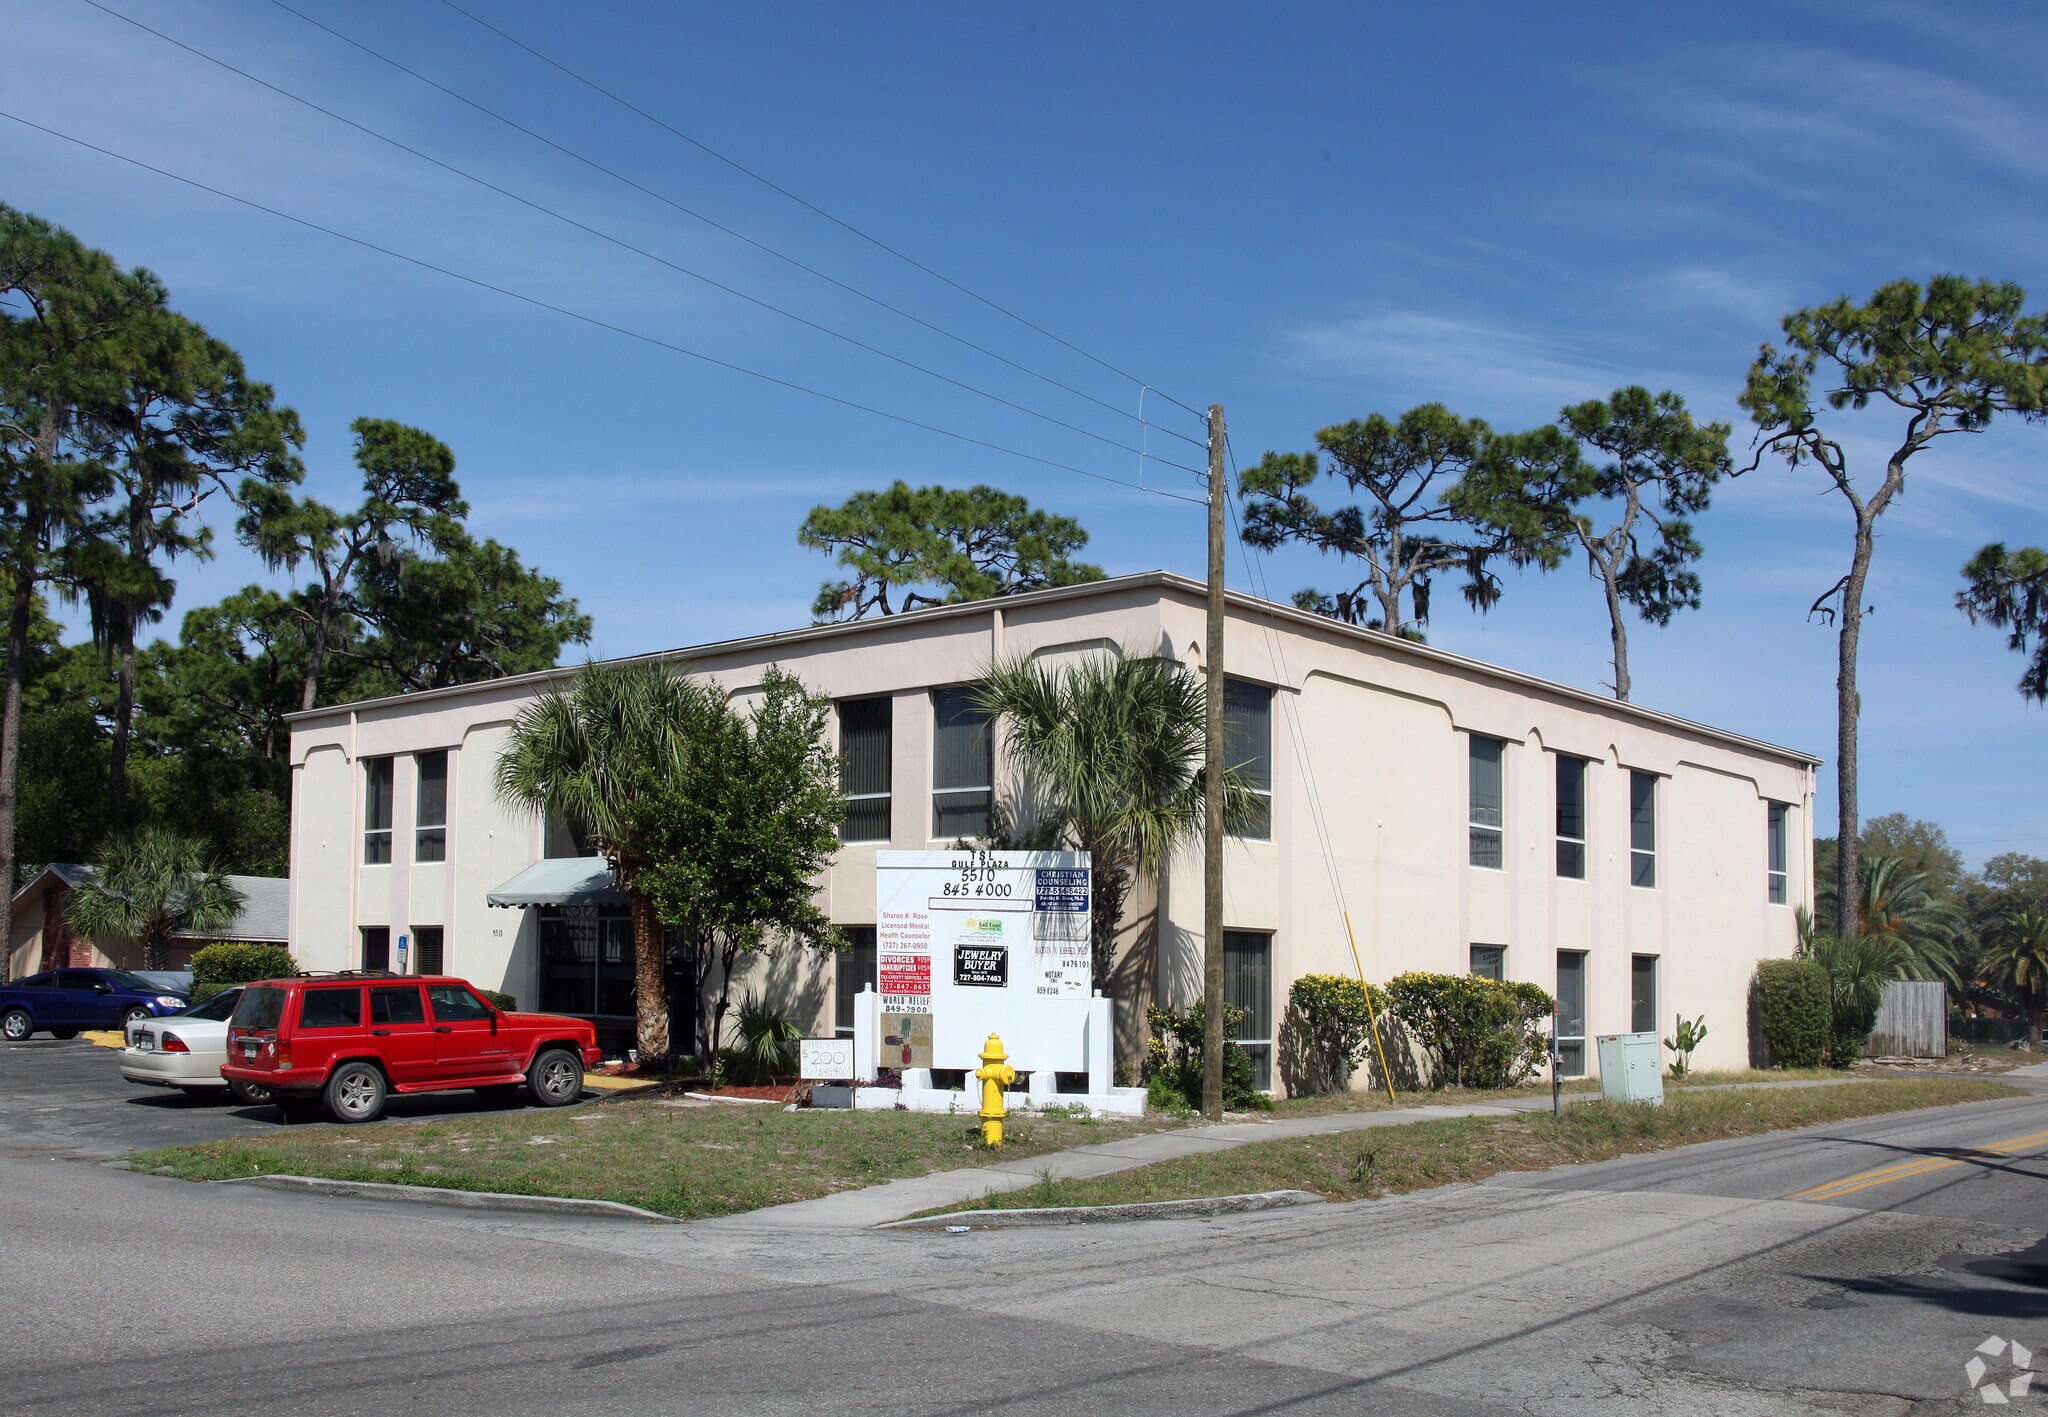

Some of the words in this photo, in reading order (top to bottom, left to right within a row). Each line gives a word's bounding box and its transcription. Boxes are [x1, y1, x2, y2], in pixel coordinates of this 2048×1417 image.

[952, 860, 974, 869] GULF
[981, 860, 1009, 869] PLAZA
[961, 868, 995, 882] 5510
[1037, 878, 1087, 886] COUNSELING
[943, 883, 969, 896] 845
[975, 883, 1012, 897] 4000
[882, 941, 898, 950] (727)
[957, 950, 1005, 961] JEWELRY
[963, 960, 997, 970] BUYER
[1045, 970, 1063, 979] NOTARY
[883, 995, 905, 1004] WORLD
[909, 996, 930, 1005] RELIEF
[885, 1005, 927, 1013] 849-7900
